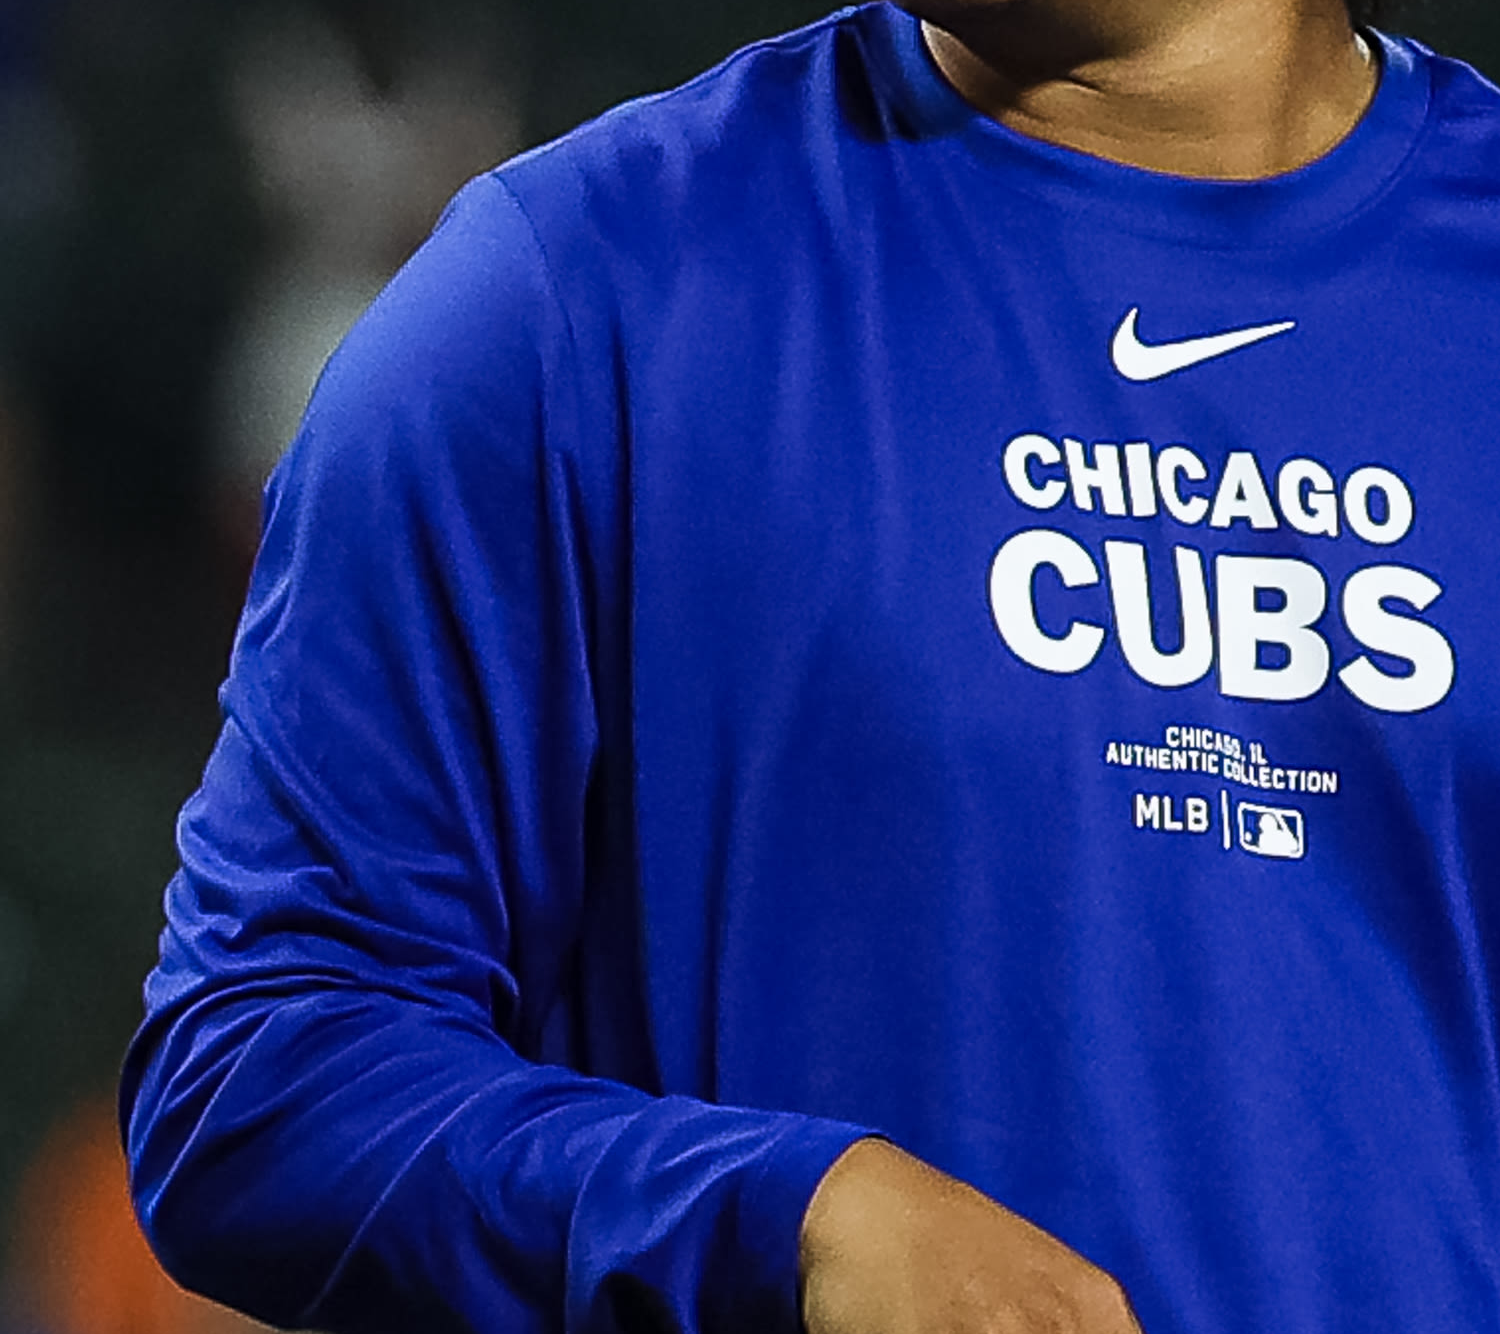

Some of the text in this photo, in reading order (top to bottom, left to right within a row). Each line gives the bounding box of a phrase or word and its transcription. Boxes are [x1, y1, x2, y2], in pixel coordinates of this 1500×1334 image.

[1003, 433, 1414, 545] CHICAGO
[989, 528, 1455, 713] CUBS
[1106, 742, 1338, 794] AUTHENTIC COLLECTION
[1248, 741, 1269, 765] IL
[1135, 793, 1209, 834] MLB
